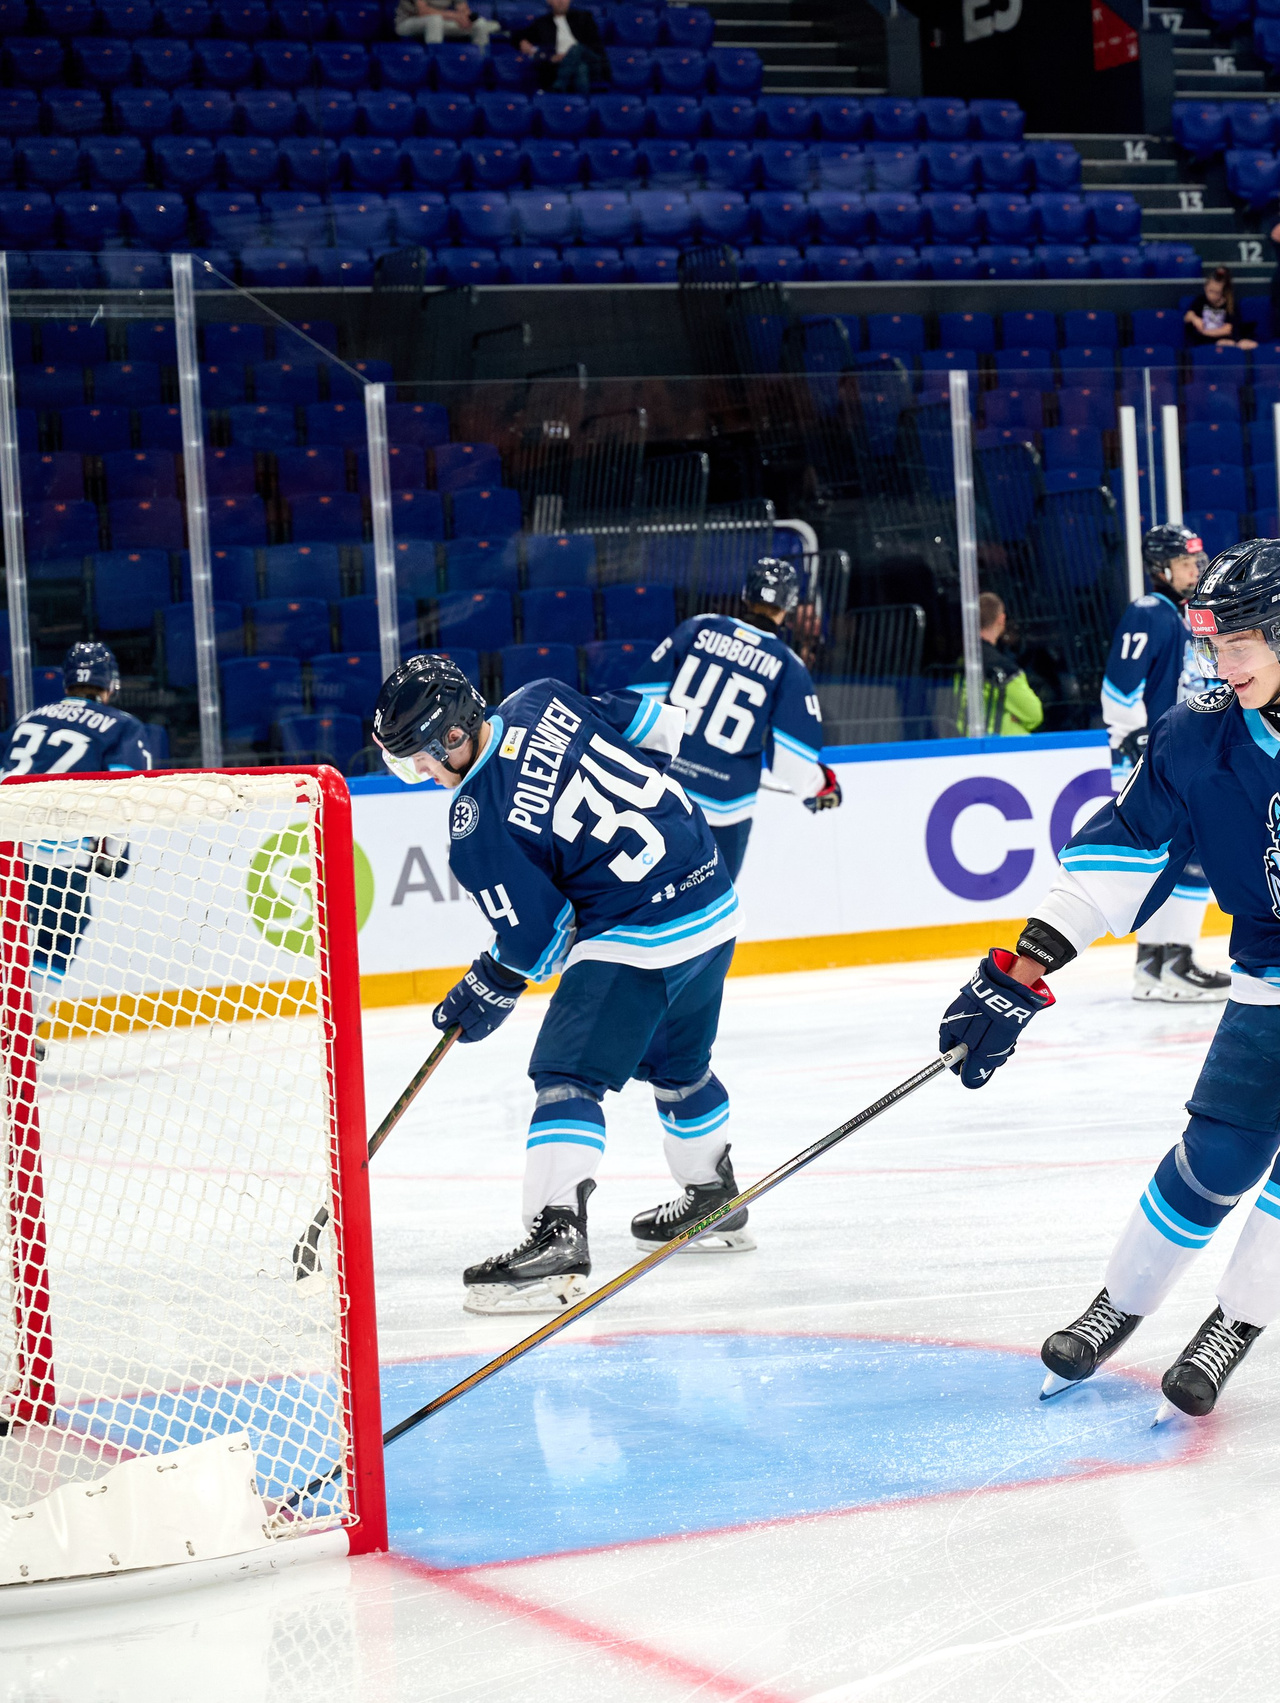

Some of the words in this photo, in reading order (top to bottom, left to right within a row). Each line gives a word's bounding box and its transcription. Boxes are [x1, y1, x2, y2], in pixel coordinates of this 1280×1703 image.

[1161, 13, 1183, 33] 17
[1213, 56, 1237, 74] 16
[1123, 140, 1148, 162] 14
[1178, 191, 1203, 212] 13
[1238, 241, 1263, 263] 12
[760, 586, 776, 602] 46
[693, 628, 783, 681] SUBBOTIN
[1120, 632, 1148, 660] 17
[76, 668, 91, 682] 37
[669, 653, 767, 755] 46
[804, 694, 822, 722] 4
[1, 722, 92, 783] 37
[552, 732, 694, 882] 34
[1019, 940, 1054, 963] BAUER
